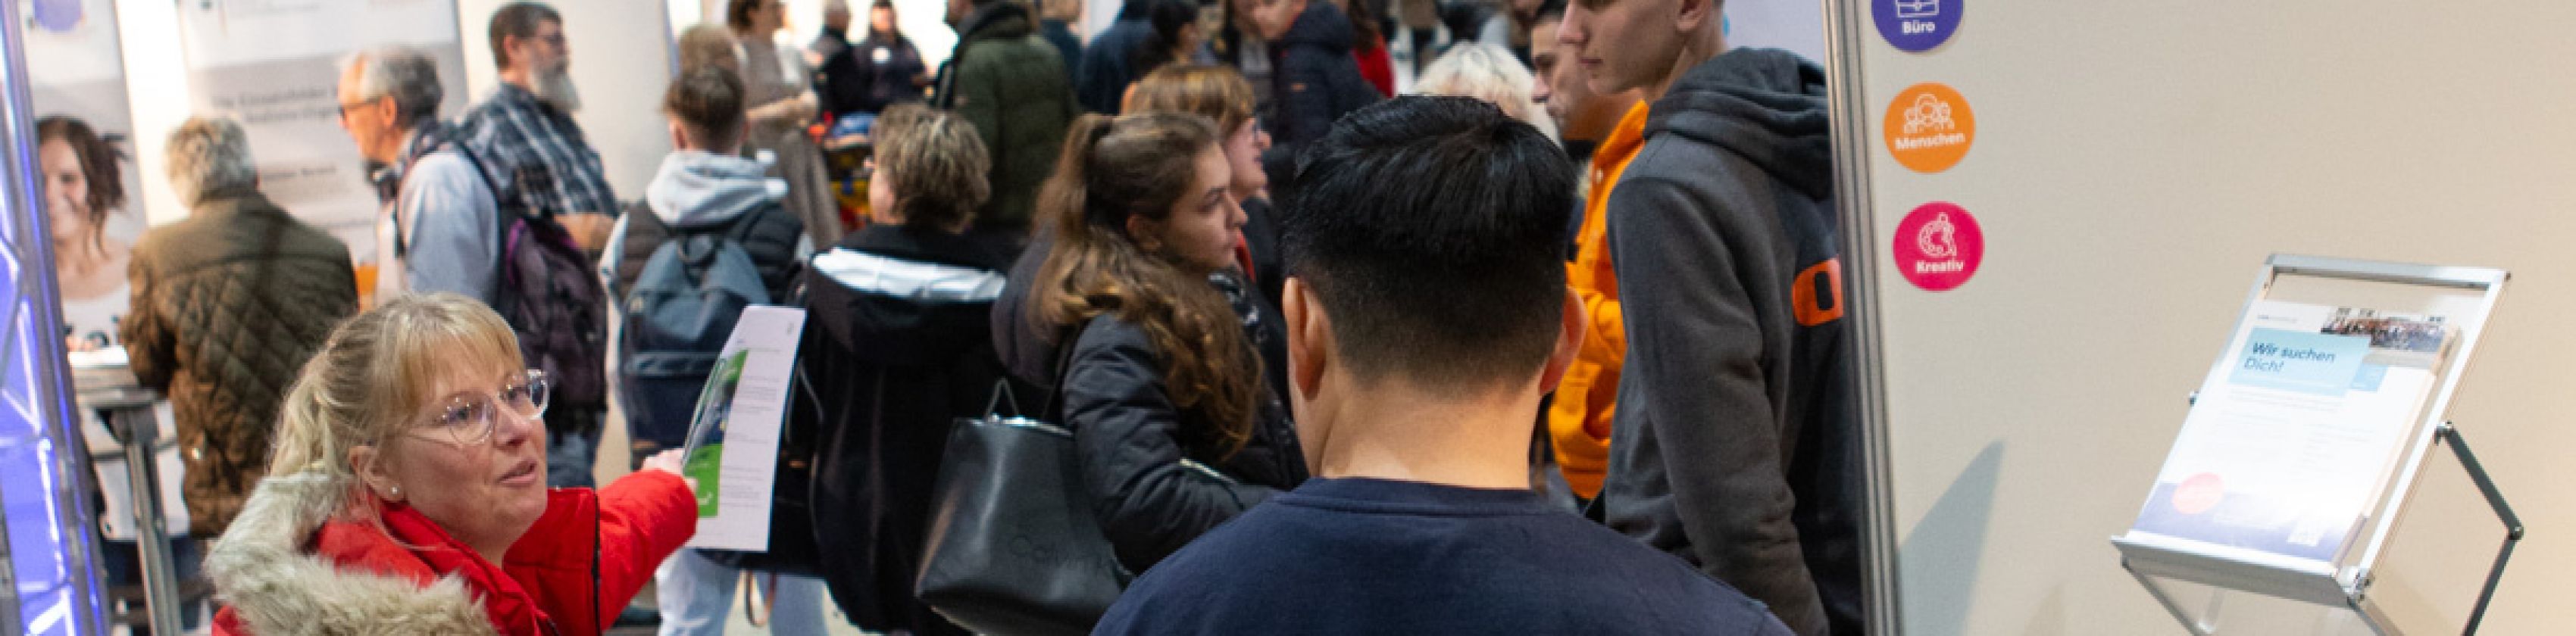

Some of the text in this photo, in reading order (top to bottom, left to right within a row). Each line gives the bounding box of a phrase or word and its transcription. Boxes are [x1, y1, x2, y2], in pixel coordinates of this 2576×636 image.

[1902, 20, 1936, 35] Büro
[1895, 132, 1965, 151] Menschen
[1916, 259, 1965, 273] Kreativ
[2252, 342, 2335, 363] Wir suchen
[2243, 356, 2285, 373] Dich!
